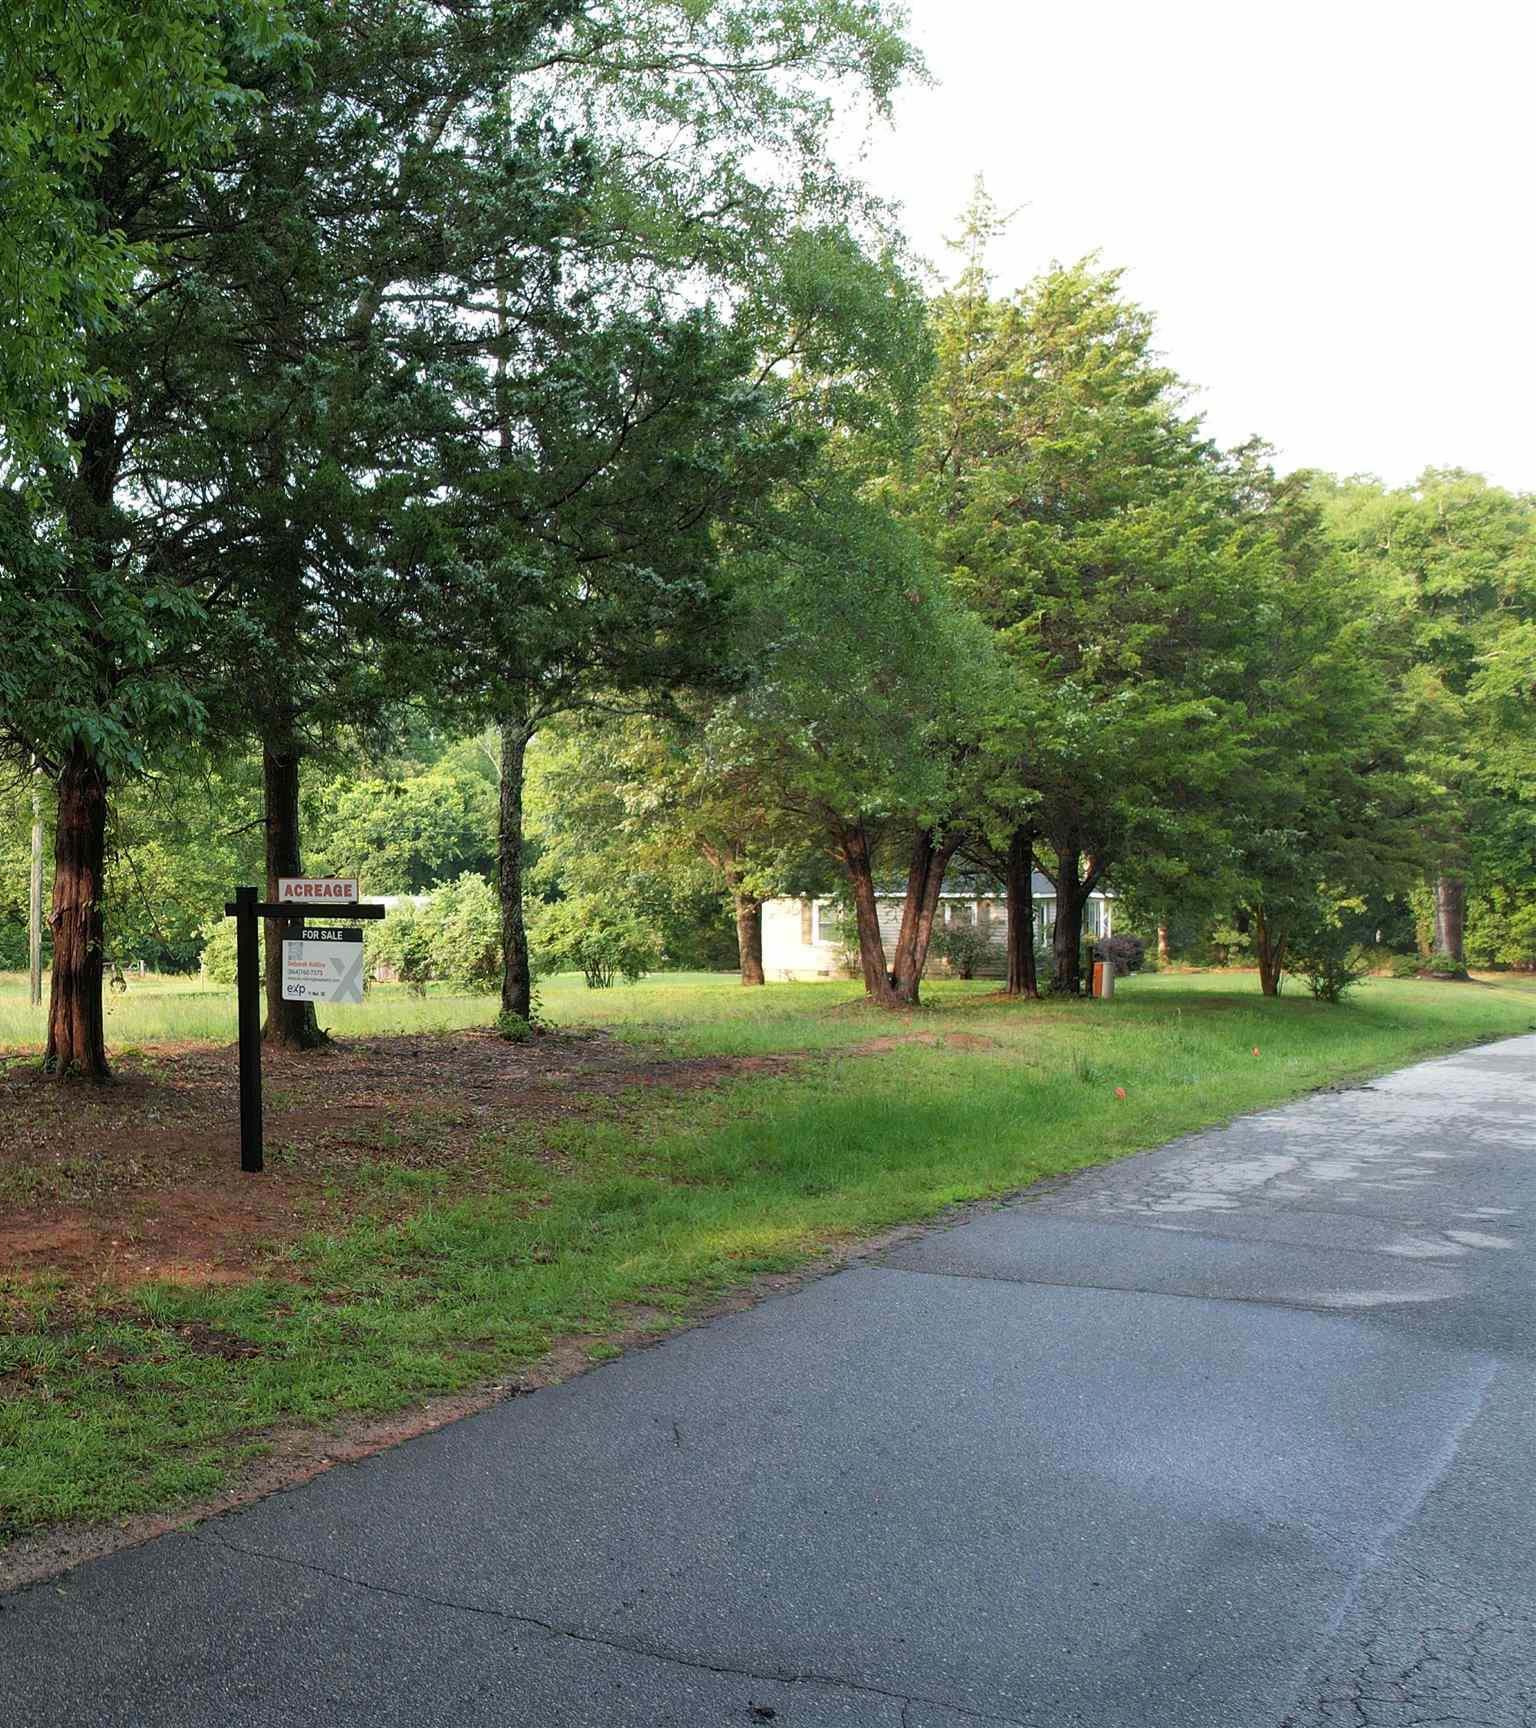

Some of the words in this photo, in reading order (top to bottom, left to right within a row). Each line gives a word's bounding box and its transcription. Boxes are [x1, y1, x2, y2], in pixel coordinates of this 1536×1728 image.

[284, 884, 352, 897] ACREAGE
[302, 930, 319, 940] FOR
[321, 930, 343, 940] SALE
